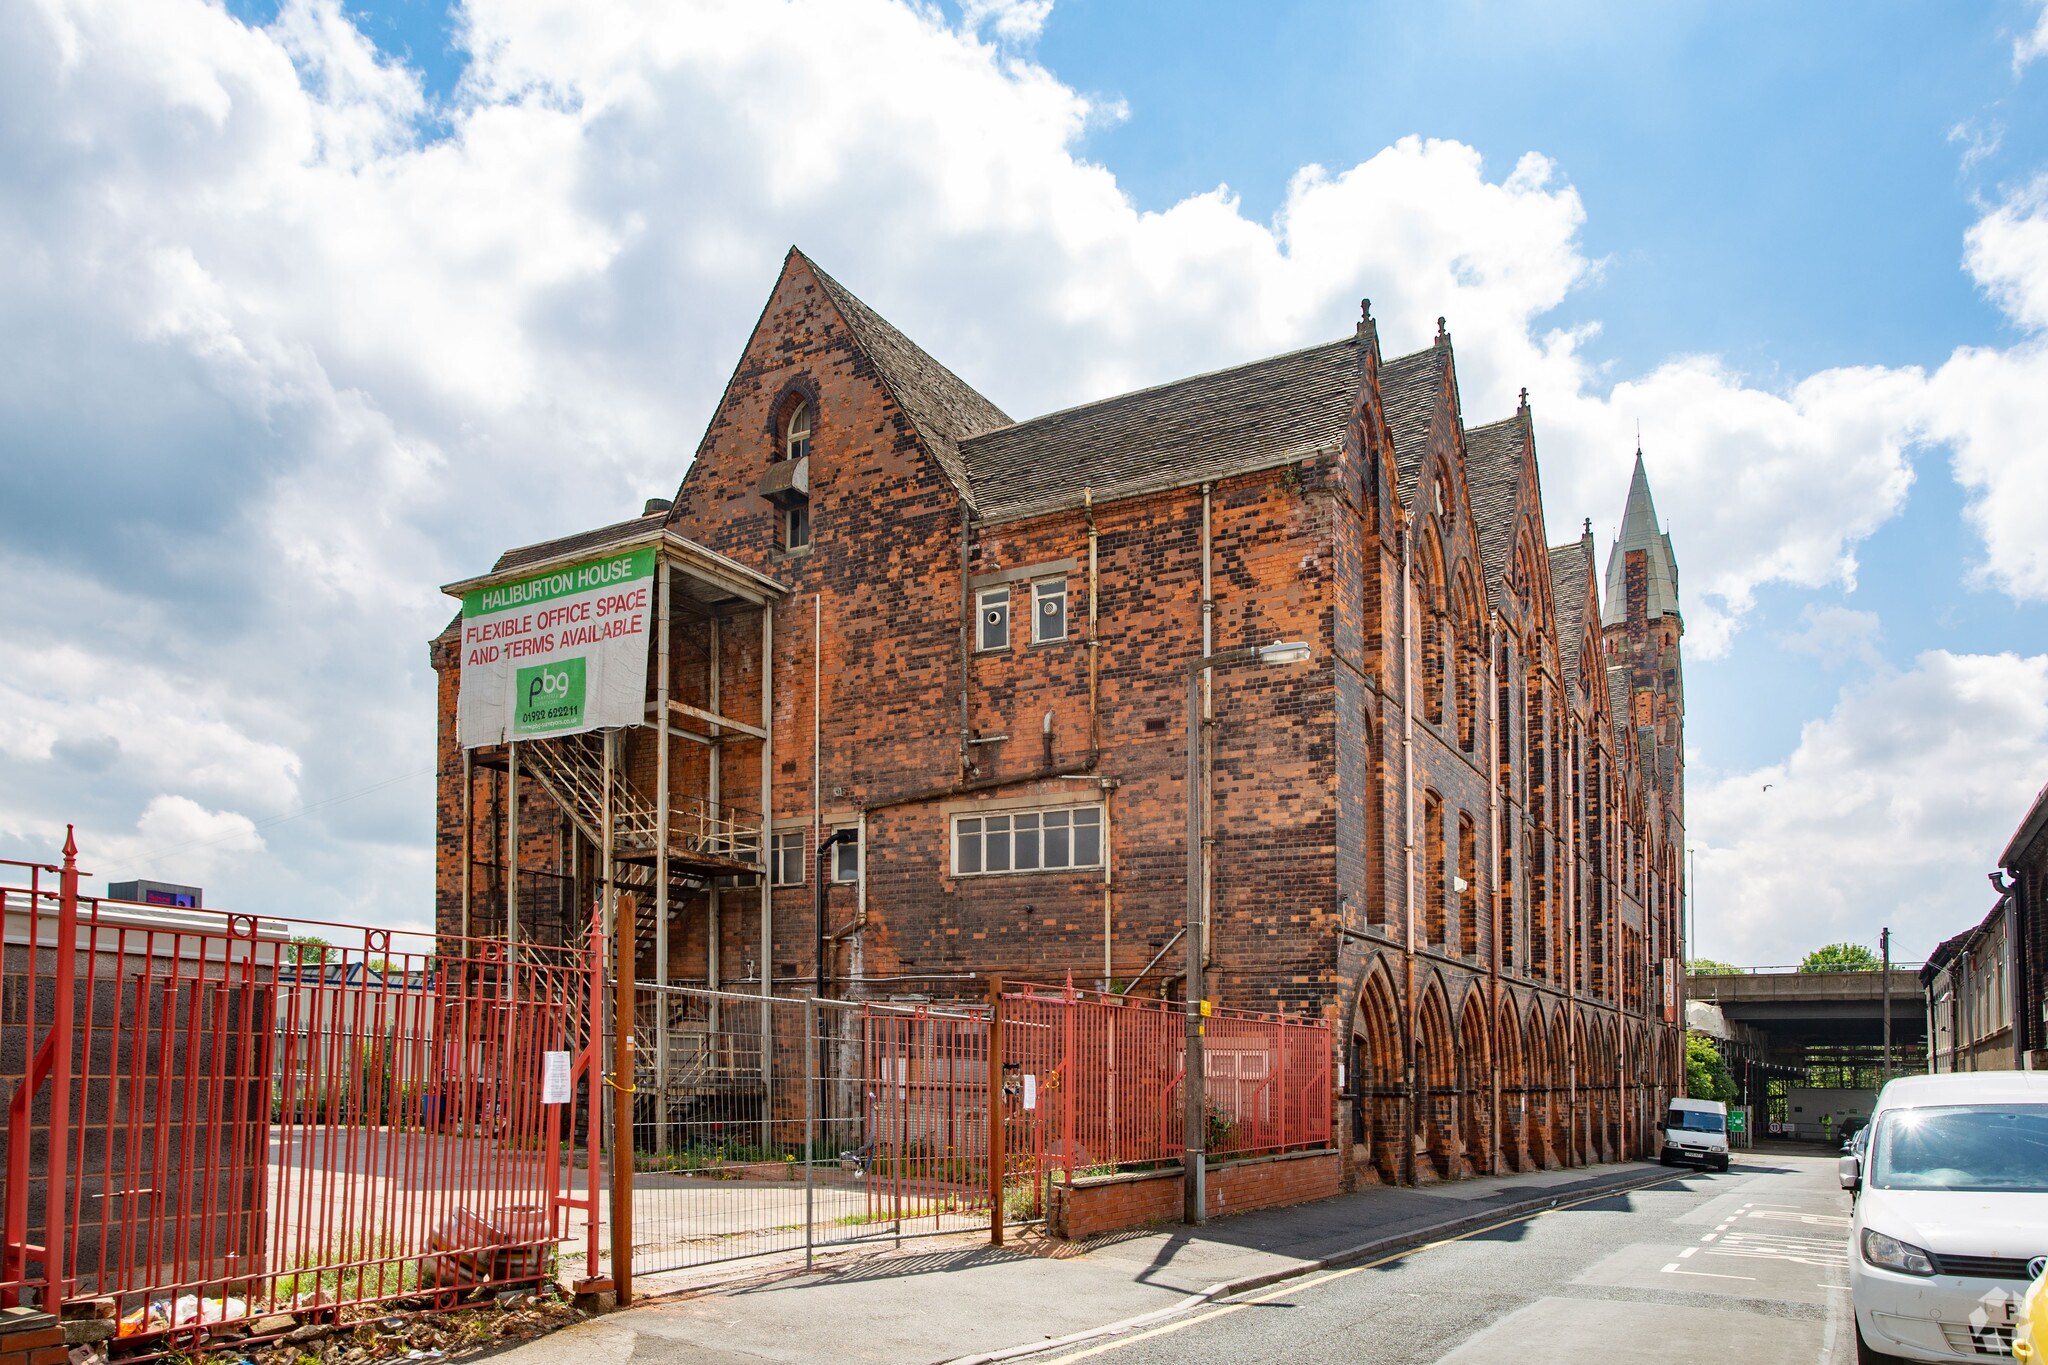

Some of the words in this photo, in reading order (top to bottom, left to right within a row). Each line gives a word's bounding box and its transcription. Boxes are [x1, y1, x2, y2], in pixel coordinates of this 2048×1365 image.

[482, 572, 573, 610] HALIBURTON
[578, 558, 632, 589] HOUSE
[467, 615, 532, 644] FLEXIBLE
[537, 602, 591, 630] OFFICE
[596, 588, 646, 617] SPACE
[468, 645, 499, 666] AND
[505, 633, 555, 660] TERMS
[559, 615, 642, 649] AVAILABLE
[529, 668, 569, 708] pbg
[523, 709, 546, 723] 01922
[547, 705, 578, 719] 622211
[1665, 959, 1673, 1006] KENRICK
